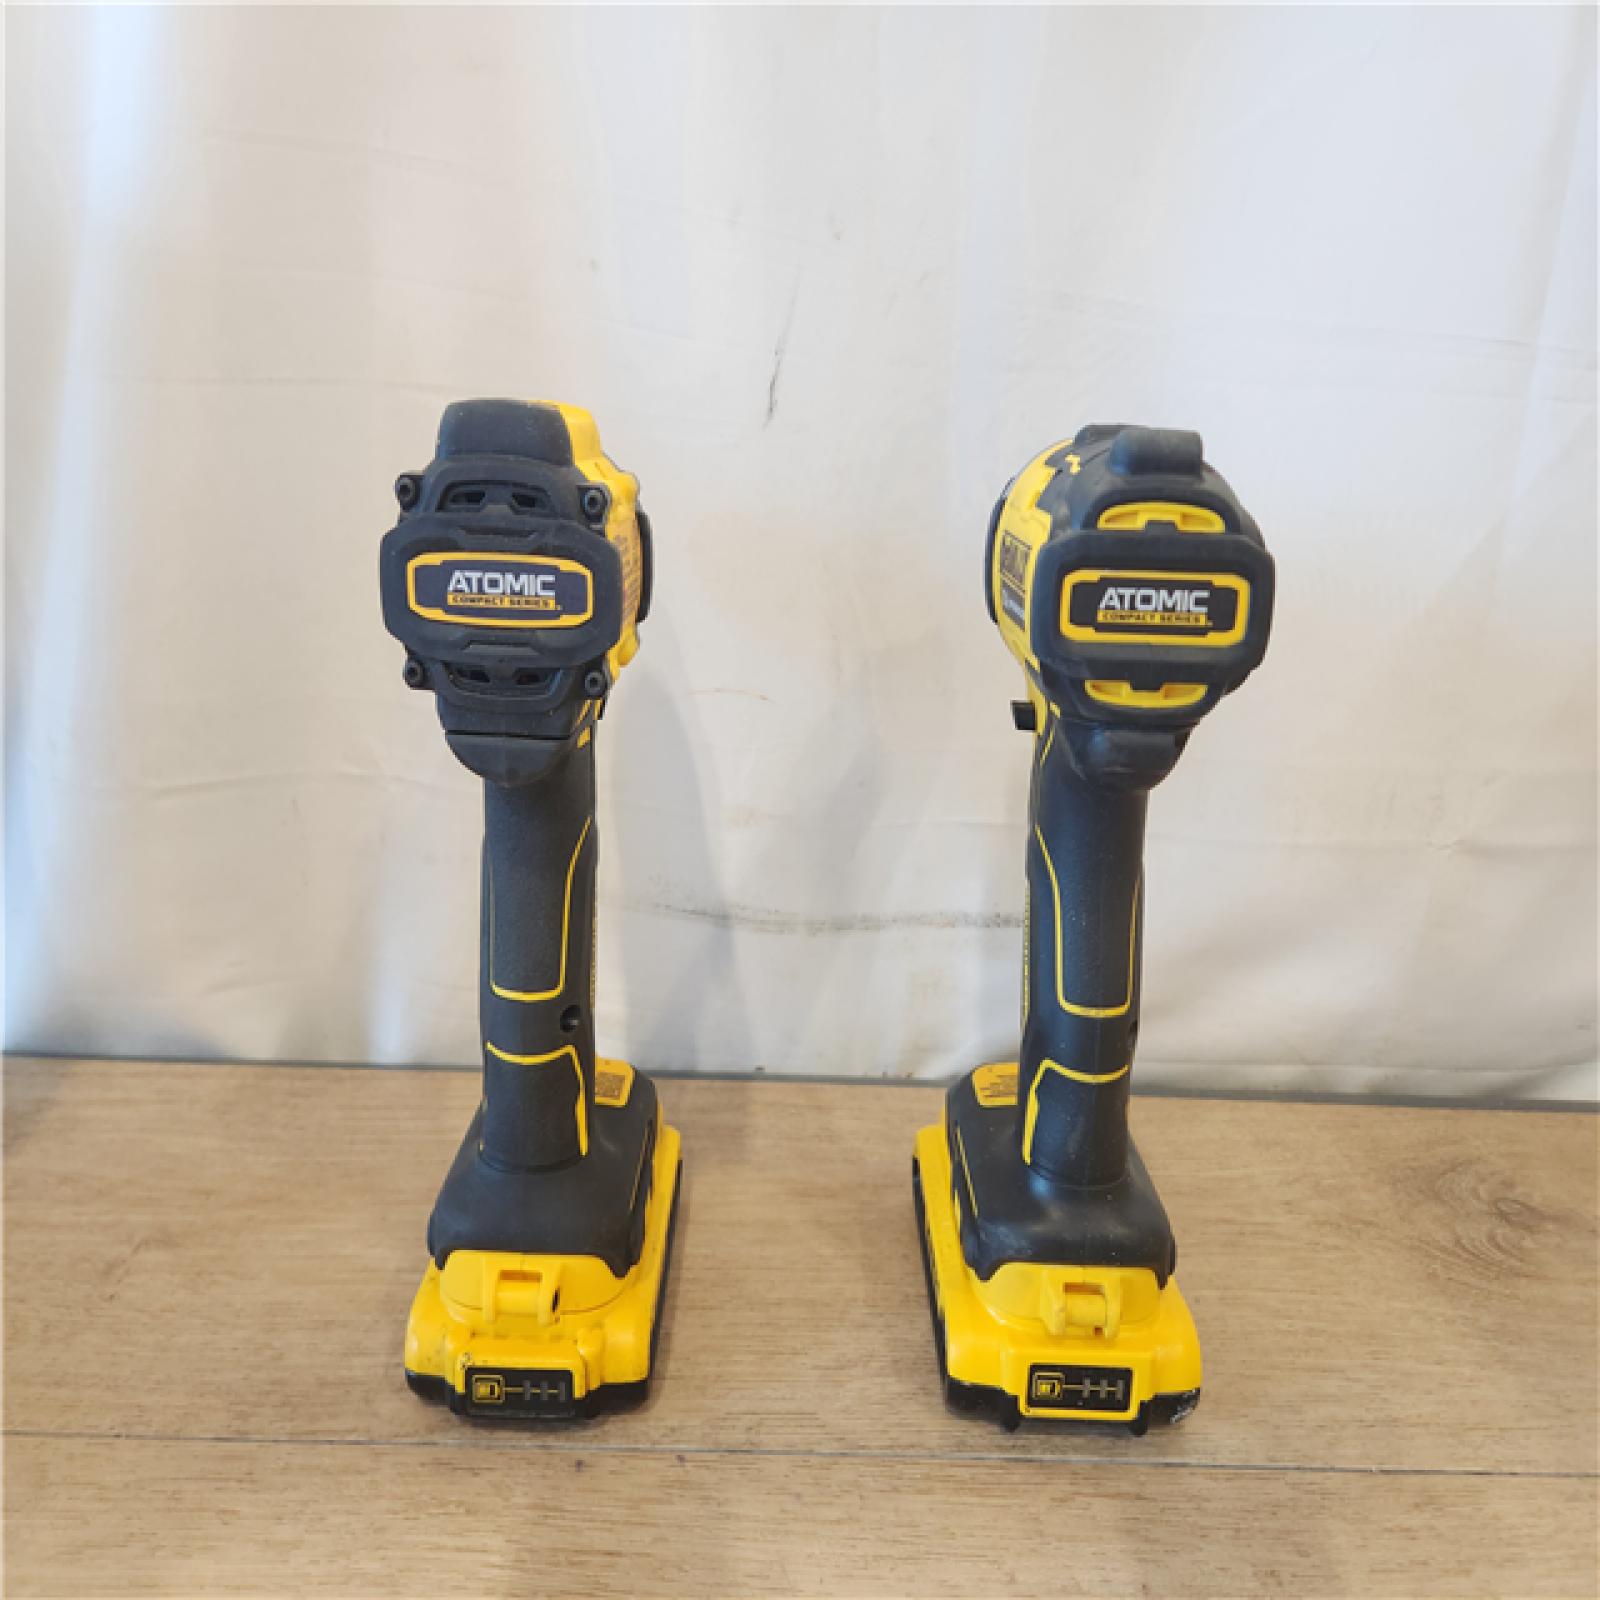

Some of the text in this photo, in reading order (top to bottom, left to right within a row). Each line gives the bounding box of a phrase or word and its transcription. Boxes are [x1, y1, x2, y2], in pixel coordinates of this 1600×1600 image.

[448, 570, 555, 596] ATOMIC
[452, 594, 550, 608] COMPACT SERIES
[1099, 587, 1210, 612] ATOMIC
[1102, 611, 1201, 624] COMPACT SERIES
